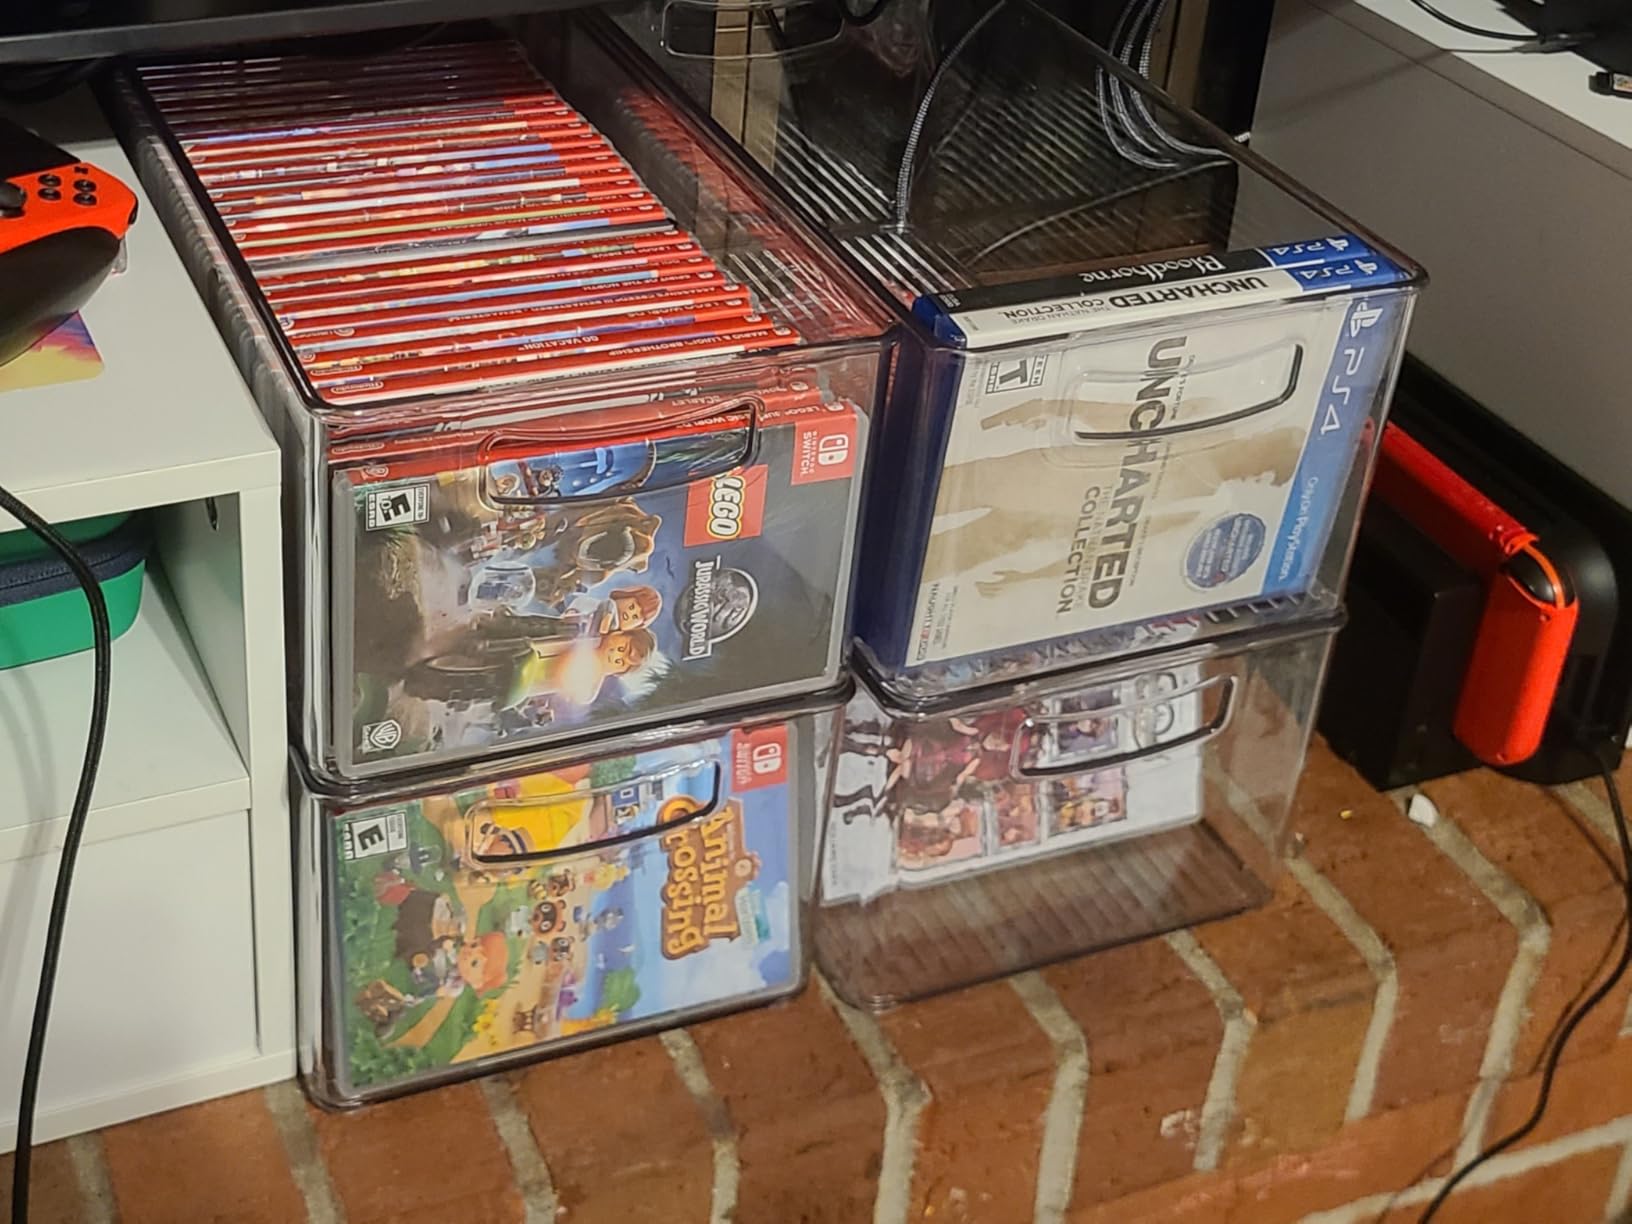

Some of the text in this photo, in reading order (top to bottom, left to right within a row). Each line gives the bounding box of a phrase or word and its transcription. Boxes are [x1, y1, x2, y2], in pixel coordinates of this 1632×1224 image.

[1273, 241, 1324, 256] PS4
[1301, 263, 1354, 279] PS4
[1108, 276, 1269, 308] UNCHARTED
[1002, 298, 1105, 319] COLLECTION
[583, 335, 599, 343] GO
[999, 359, 1028, 385] T
[1320, 346, 1365, 436] PS4
[800, 431, 813, 476] SWITCH
[1087, 335, 1188, 609] UNCHARTED
[380, 493, 411, 522] E
[711, 475, 743, 537] LEGO
[1055, 485, 1101, 614] COLLECTION
[358, 824, 385, 851] E
[663, 798, 705, 955] Crossing
[700, 805, 739, 936] Animal
